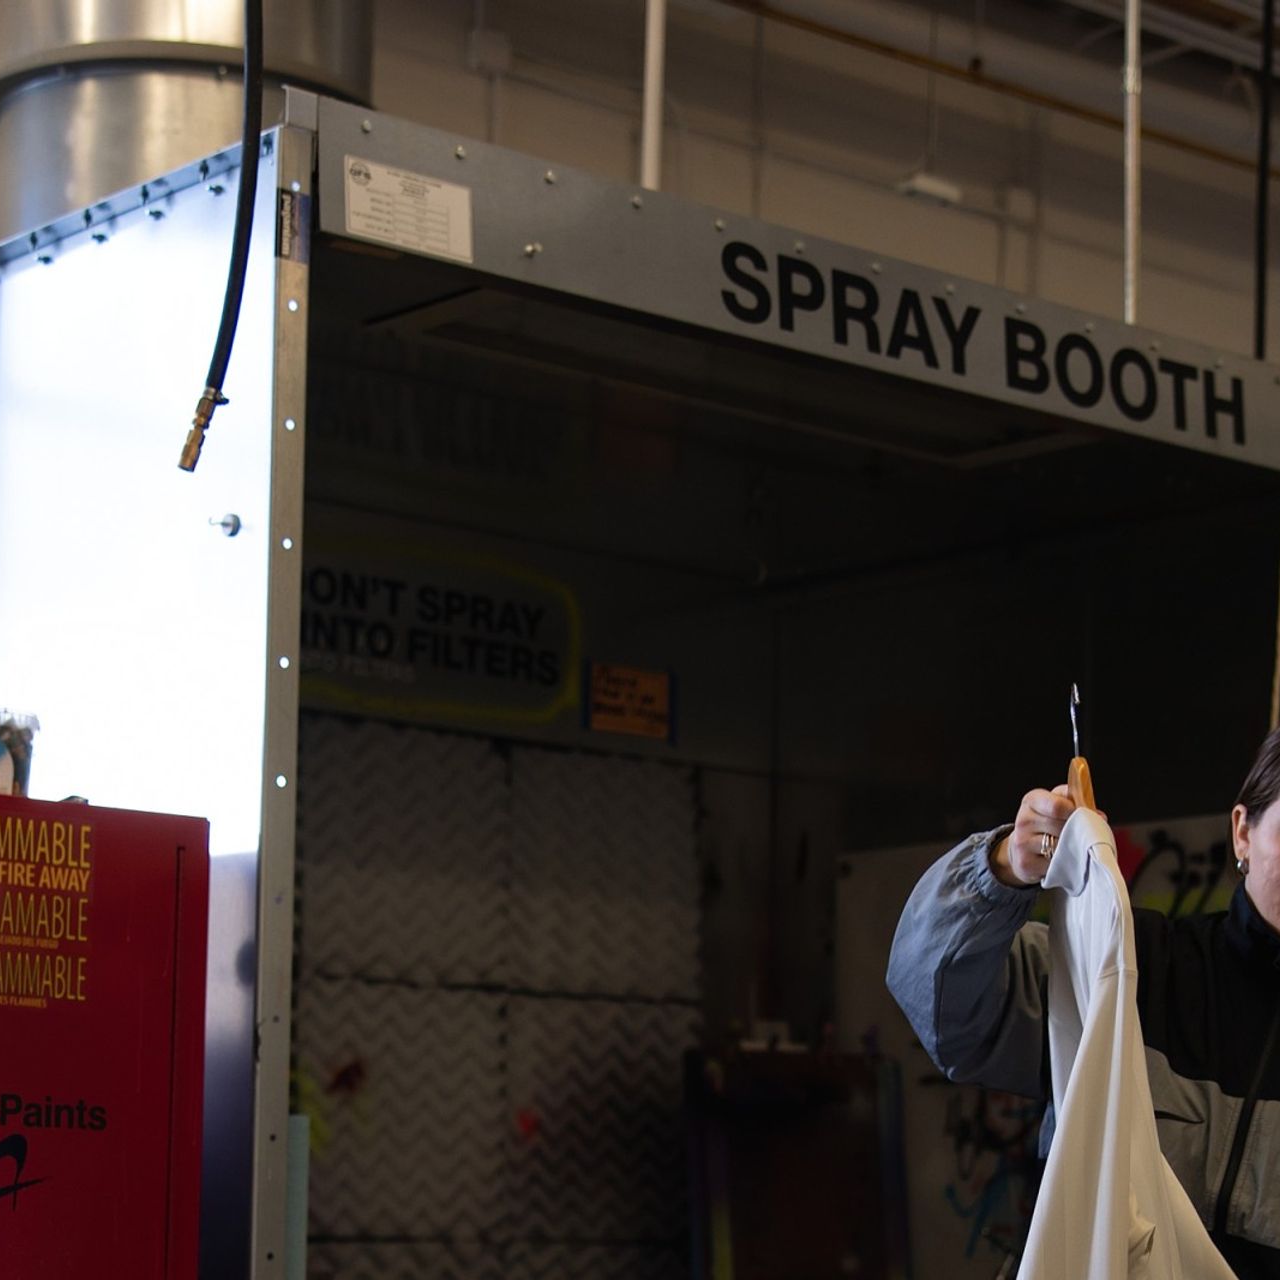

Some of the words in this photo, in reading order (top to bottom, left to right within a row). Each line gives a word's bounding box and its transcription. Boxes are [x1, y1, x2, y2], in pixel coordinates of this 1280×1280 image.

[721, 239, 981, 376] SPRAY
[1005, 316, 1247, 447] BOOTH
[308, 567, 406, 616] ON'T
[416, 585, 546, 640] SPRAY
[406, 628, 561, 686] FILTERS
[39, 865, 91, 892] AWAY
